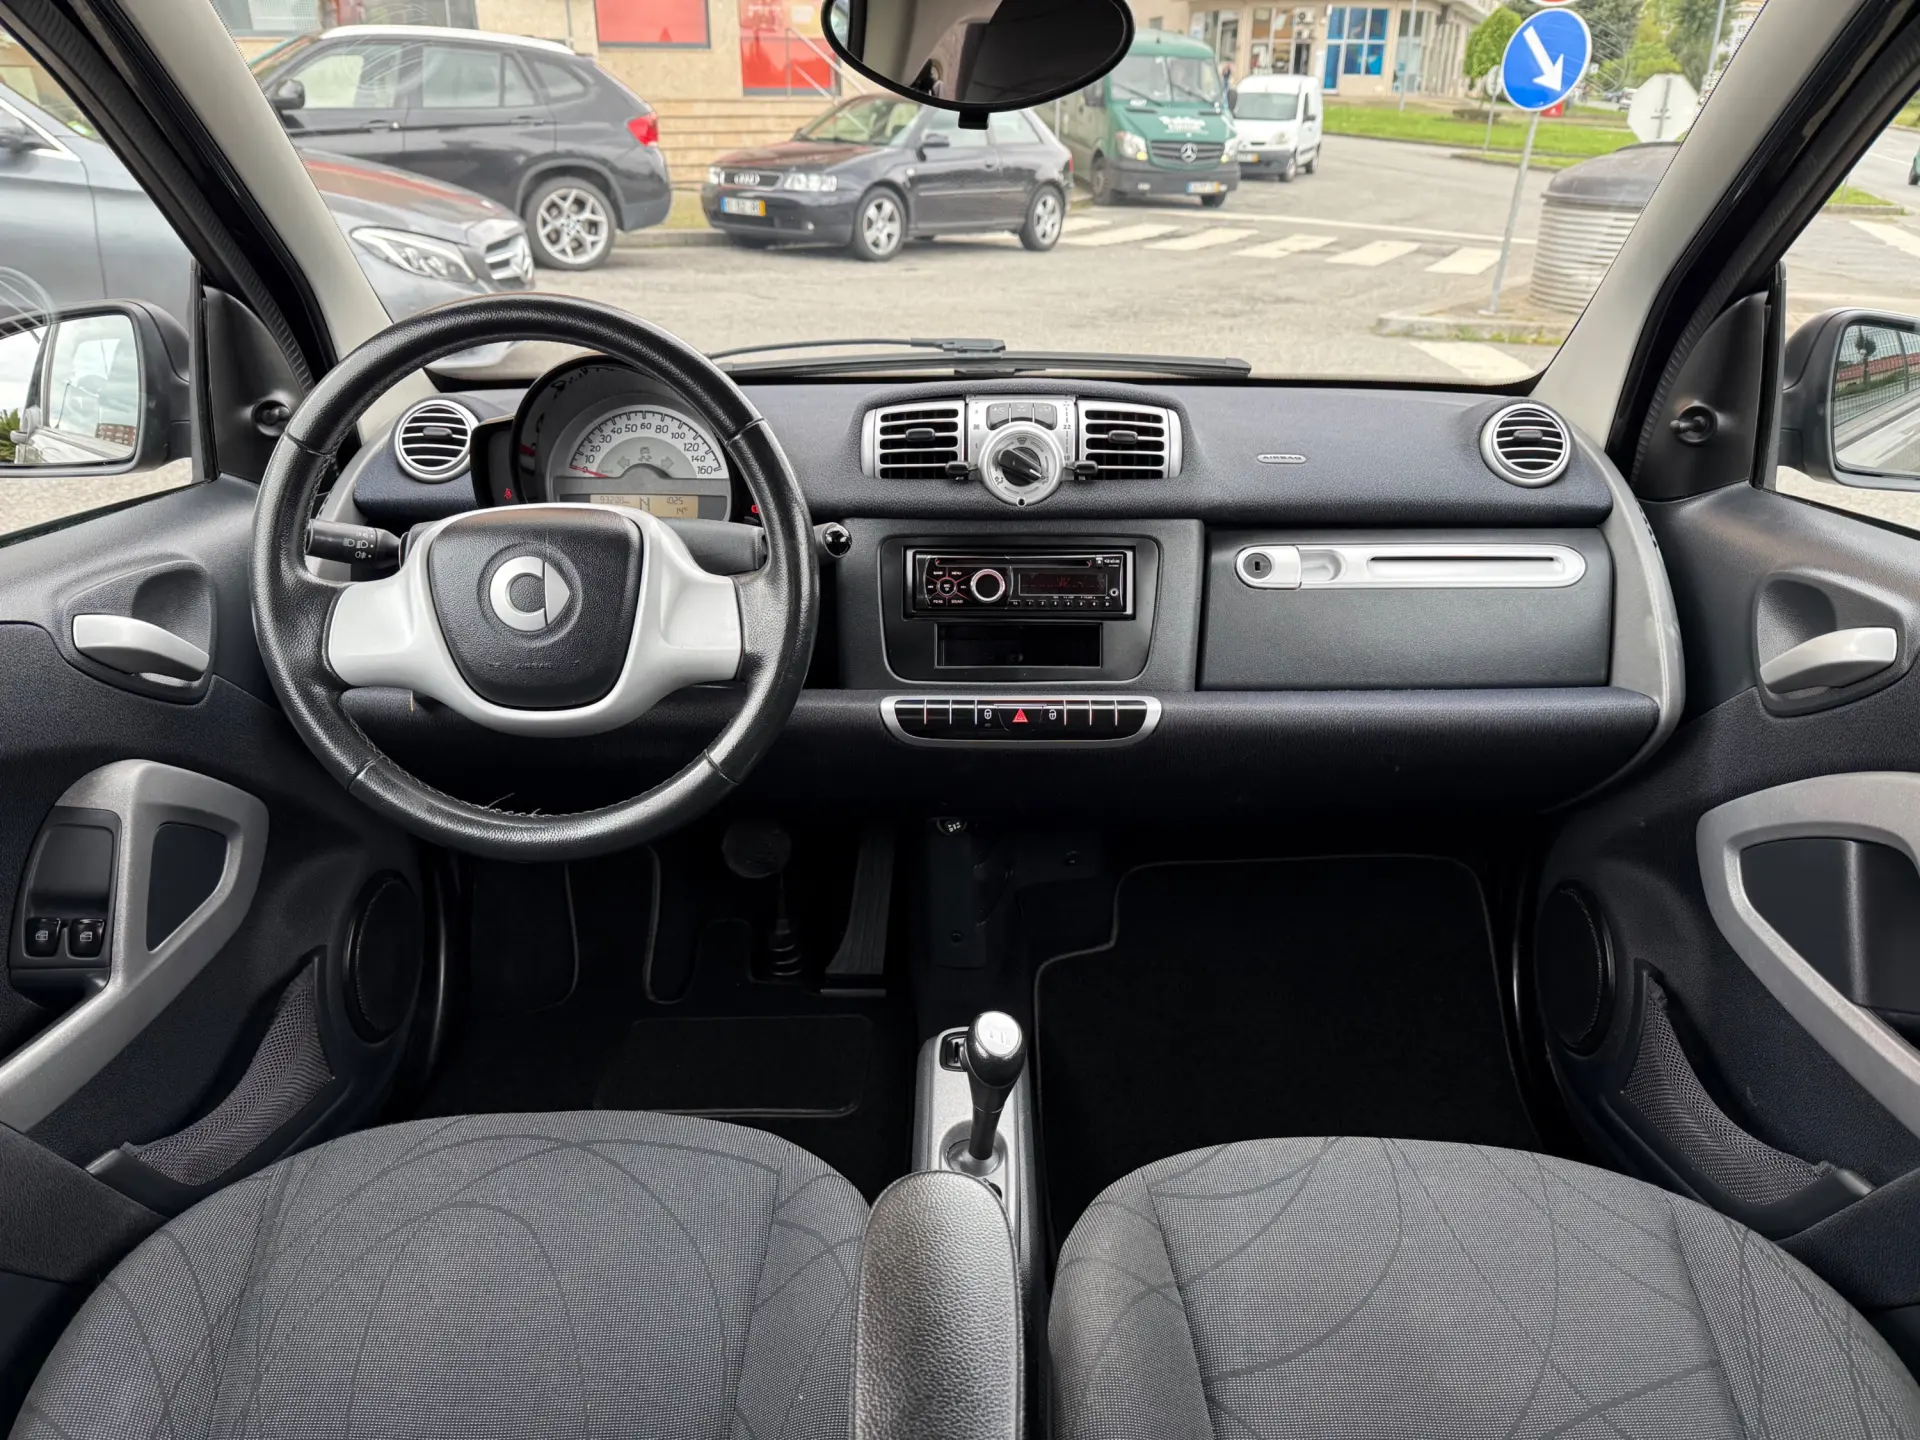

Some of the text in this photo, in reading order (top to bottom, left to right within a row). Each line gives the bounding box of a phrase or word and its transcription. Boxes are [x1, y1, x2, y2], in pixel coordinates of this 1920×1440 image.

[610, 427, 623, 435] 40
[624, 423, 638, 433] 50
[640, 422, 652, 430] 60
[655, 424, 669, 434] 80
[599, 434, 612, 444] 30
[670, 432, 686, 440] 100
[589, 444, 601, 452] 20
[683, 442, 700, 452] 120
[584, 454, 595, 464] 10
[691, 455, 706, 463] 140
[697, 465, 713, 475] 160
[639, 497, 650, 512] N
